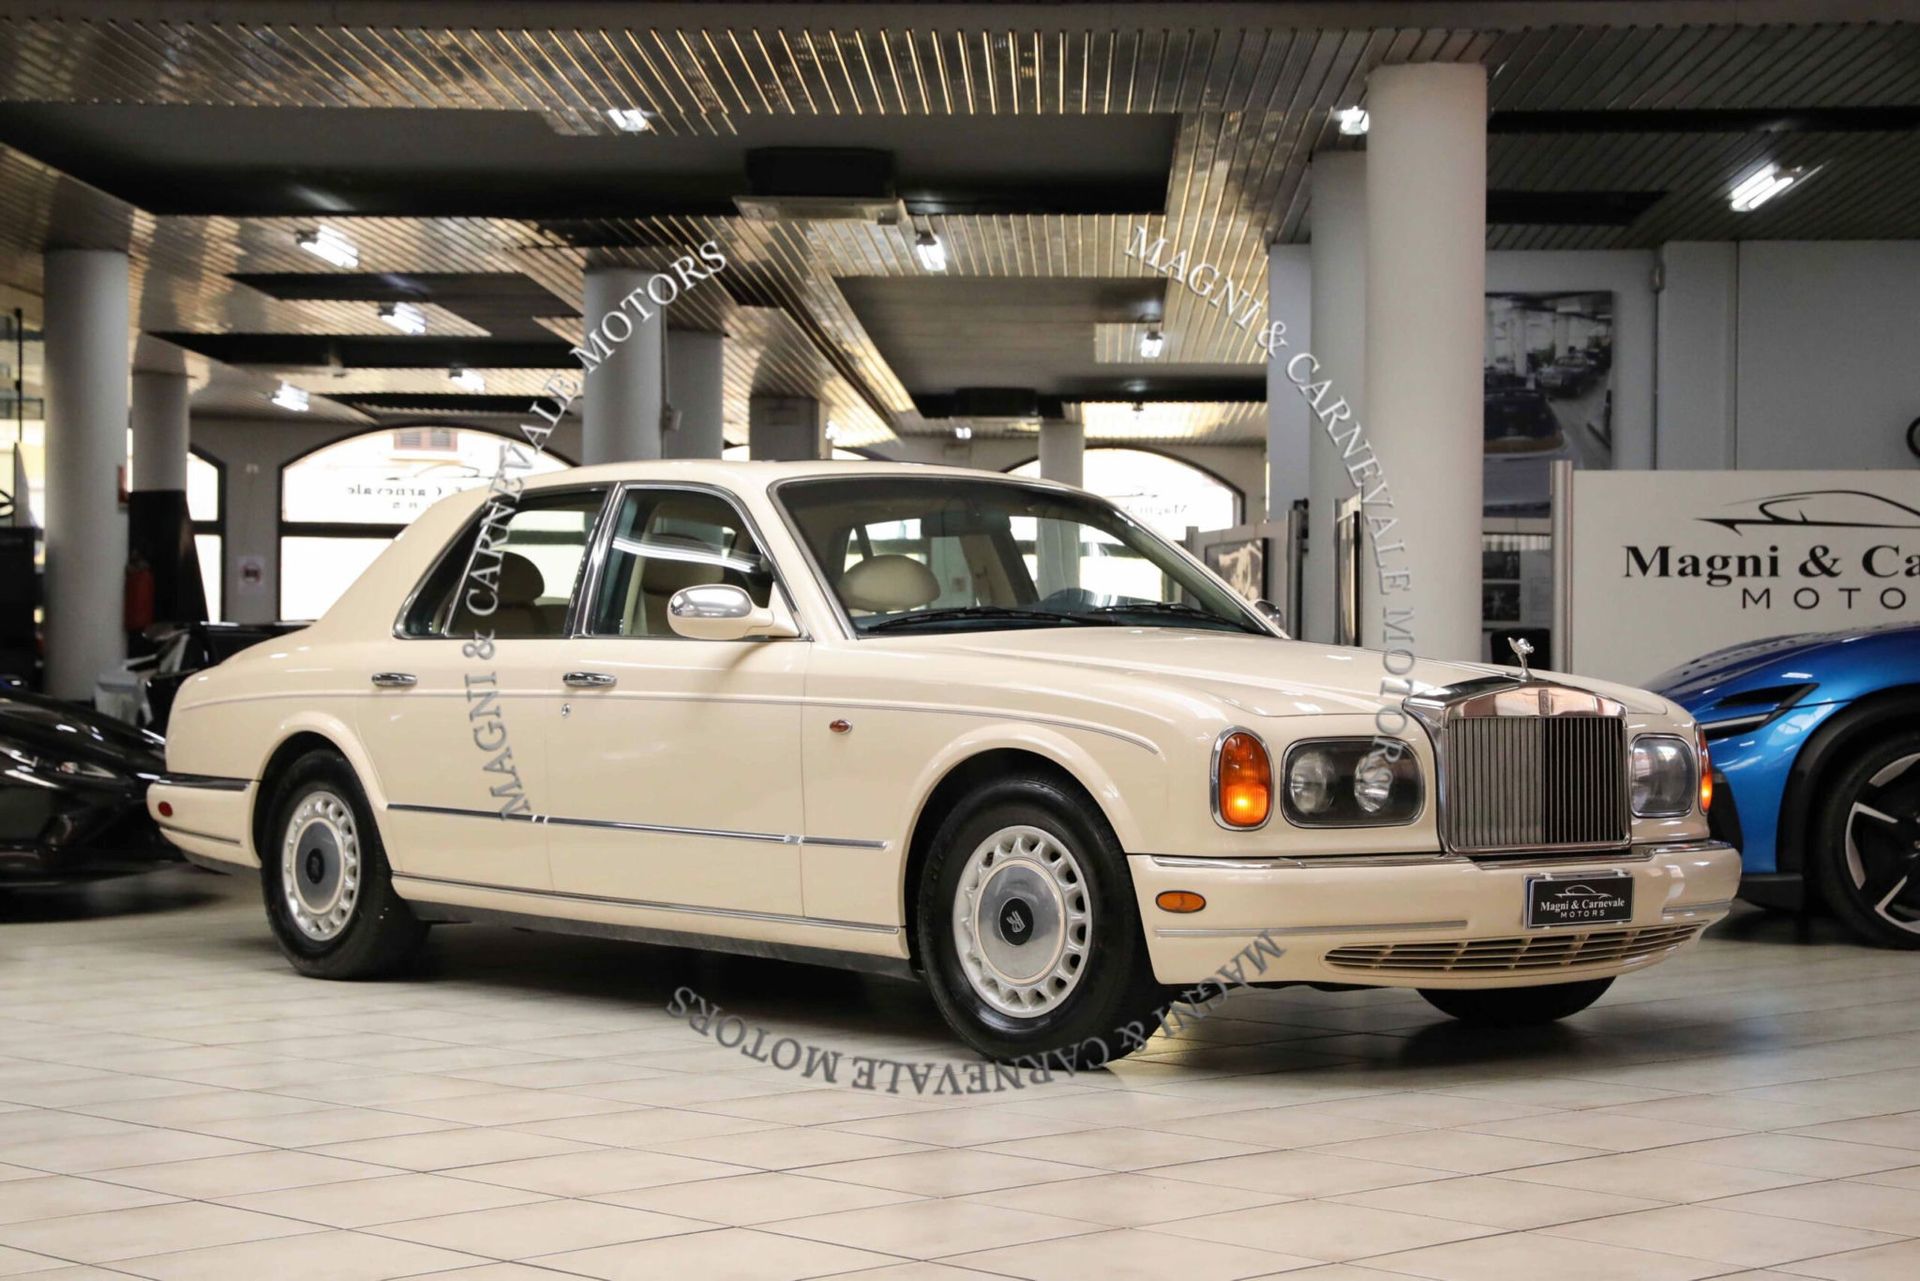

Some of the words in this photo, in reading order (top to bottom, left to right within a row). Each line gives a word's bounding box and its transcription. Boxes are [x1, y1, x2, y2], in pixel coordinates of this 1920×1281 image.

[1622, 545, 1780, 588] Magni
[1799, 545, 1842, 578] &
[1742, 588, 1906, 609] MOTO
[1541, 900, 1569, 912] Magni
[1571, 900, 1580, 909] &
[1581, 898, 1625, 910] Carnevale
[1560, 909, 1605, 918] MOTORS
